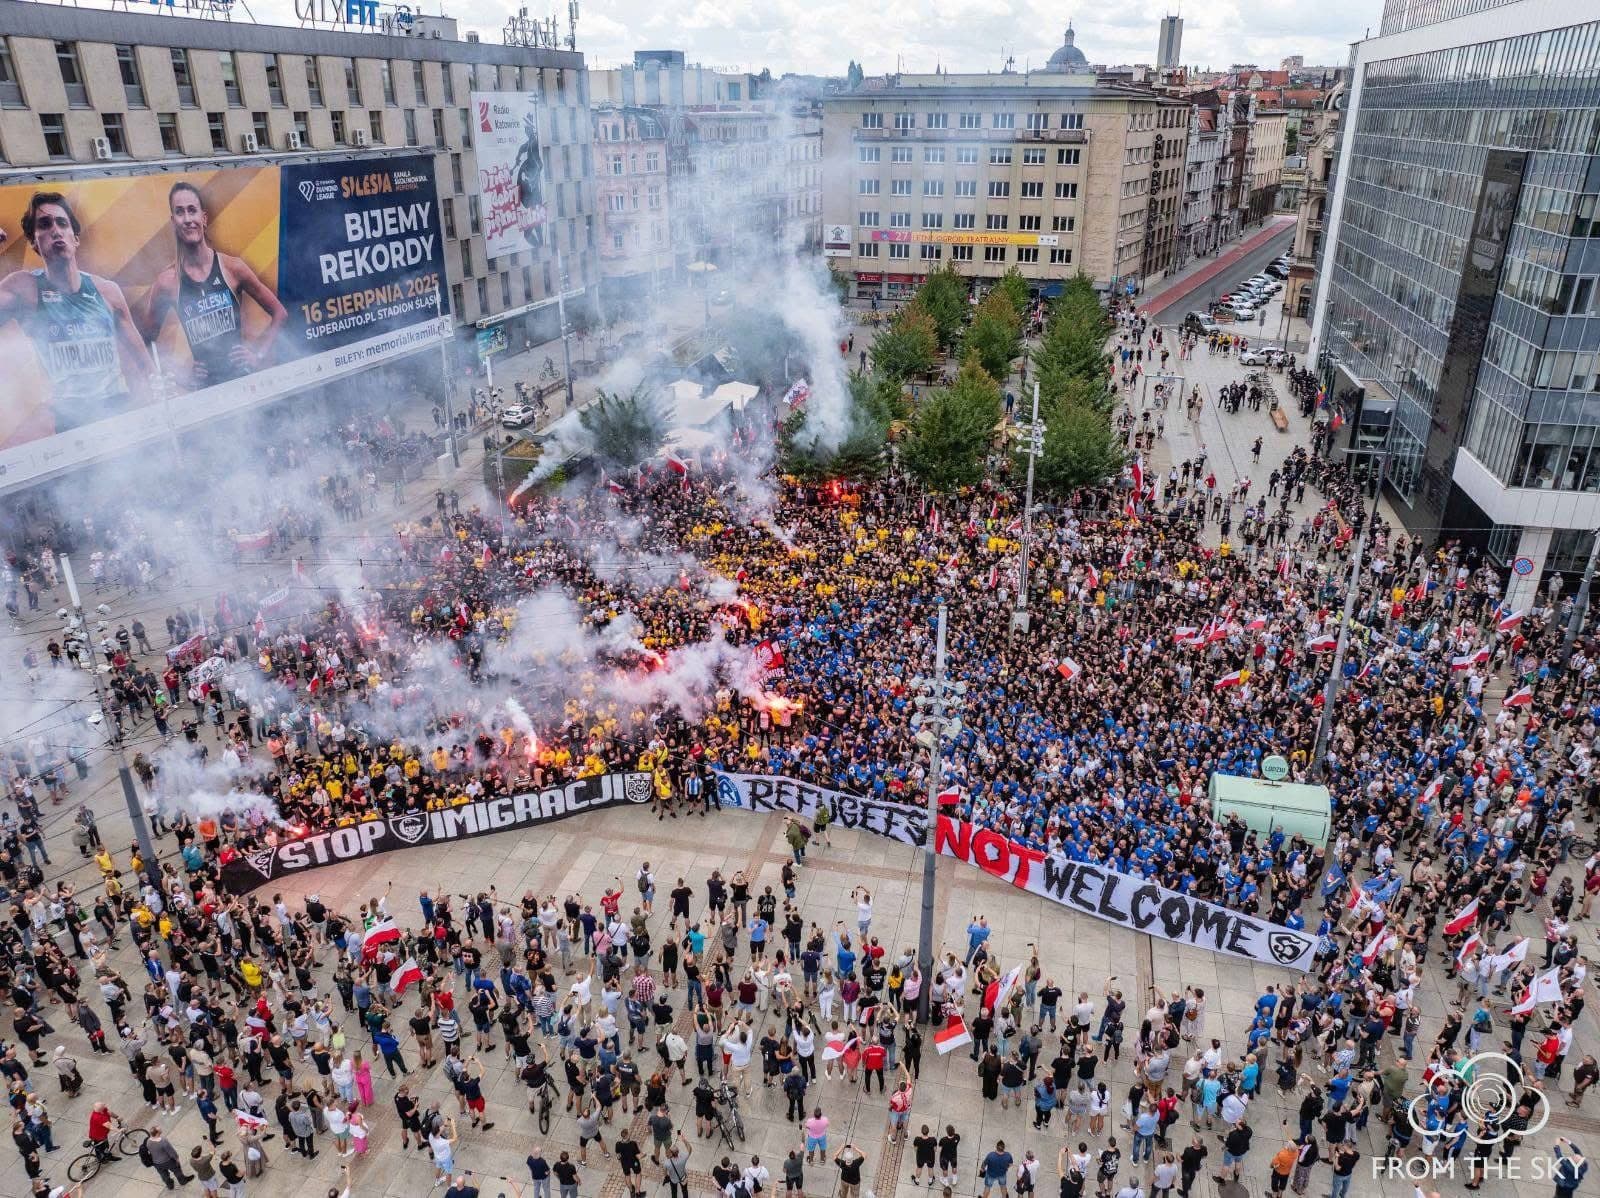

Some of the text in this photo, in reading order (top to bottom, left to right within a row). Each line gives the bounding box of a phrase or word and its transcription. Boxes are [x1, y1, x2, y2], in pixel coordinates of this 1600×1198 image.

[494, 119, 521, 130] Katowice
[341, 172, 393, 199] SILESIA
[344, 201, 431, 242] BIJEMY
[966, 235, 1010, 245] TEATRALNY
[319, 234, 434, 285] REKORDY
[197, 293, 229, 313] SILESIA
[302, 272, 440, 325] 16 SIERPNIA 2025
[305, 312, 377, 340] SUPERAUTO.PL
[377, 301, 414, 320] STADION
[334, 351, 365, 367] BILETY:
[278, 819, 386, 869] STOP
[430, 773, 624, 840] IMIGRACJI
[743, 778, 1265, 959] REFUGEES NOT WELCOME
